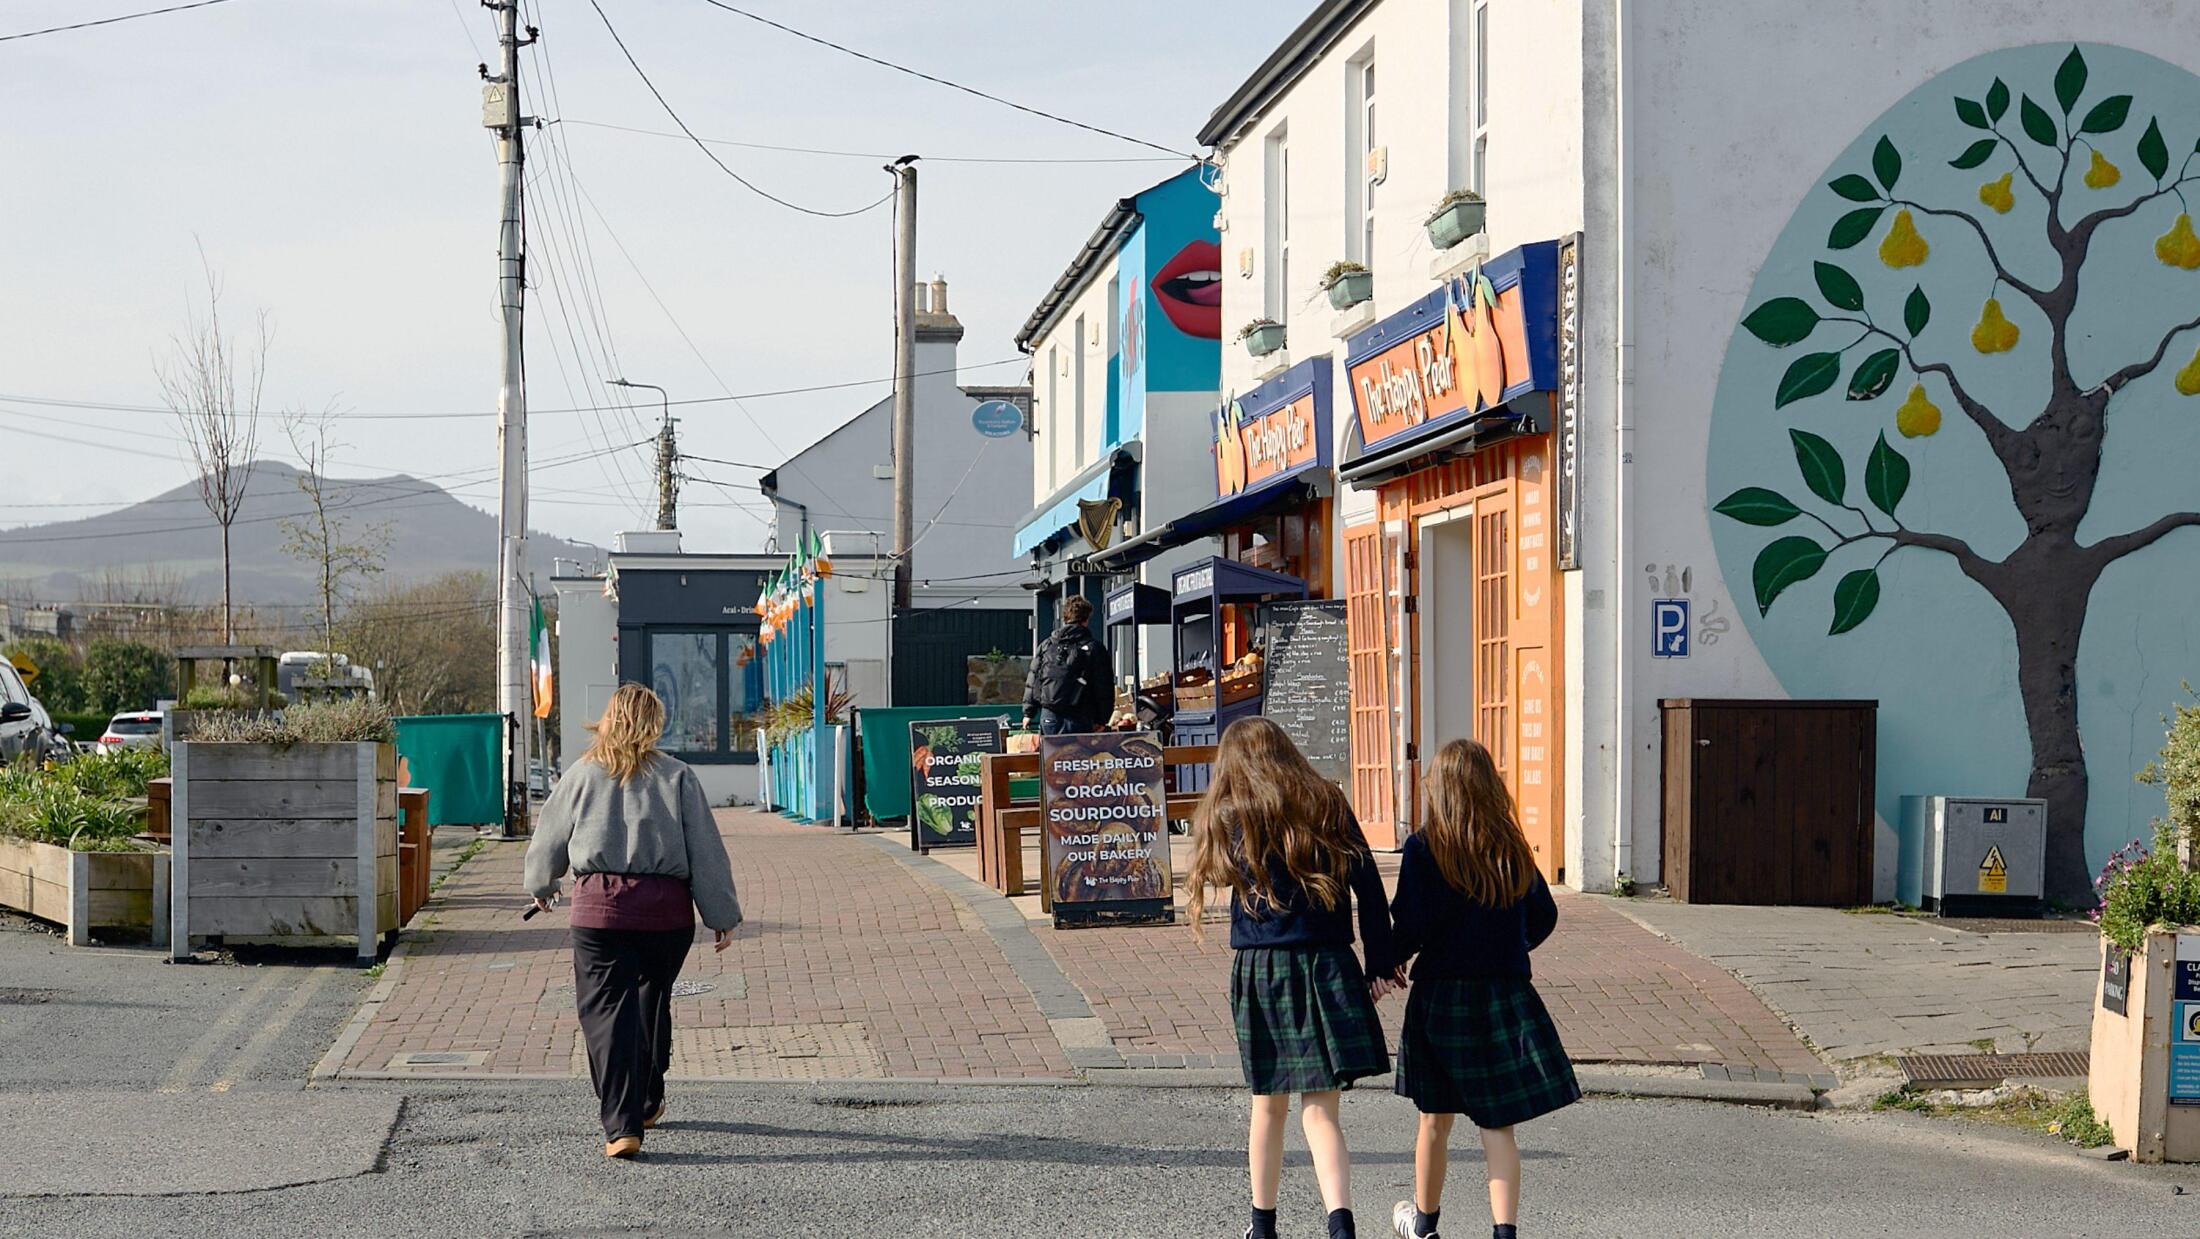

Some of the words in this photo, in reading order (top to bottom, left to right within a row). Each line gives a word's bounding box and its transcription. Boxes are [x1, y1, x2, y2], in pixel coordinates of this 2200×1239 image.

[1564, 264, 1576, 477] COURTYARD
[1362, 375, 1385, 423] The
[1380, 358, 1426, 422] Happy
[1419, 338, 1454, 398] Pear
[1246, 428, 1262, 467] The
[1259, 414, 1287, 470] Happy
[1285, 404, 1307, 452] Pear
[1524, 698, 1534, 715] GIVE
[1535, 698, 1542, 714] US
[1521, 722, 1532, 738] THIS
[1533, 721, 1543, 738] DAY
[1531, 745, 1544, 761] DAILY
[1054, 760, 1101, 772] FRESH
[1104, 757, 1155, 770] BREAD
[926, 774, 982, 787] SEASON
[1523, 769, 1542, 785] SALADS
[1065, 783, 1147, 799] ORGANIC
[1050, 805, 1164, 822] SOURDOUGH
[1060, 833, 1100, 846] MADE
[1103, 832, 1145, 845] DAILY
[1142, 832, 1157, 843] IN
[1067, 852, 1097, 863] OUR
[1100, 849, 1152, 862] BAKERY
[2104, 981, 2124, 1001] PARKING
